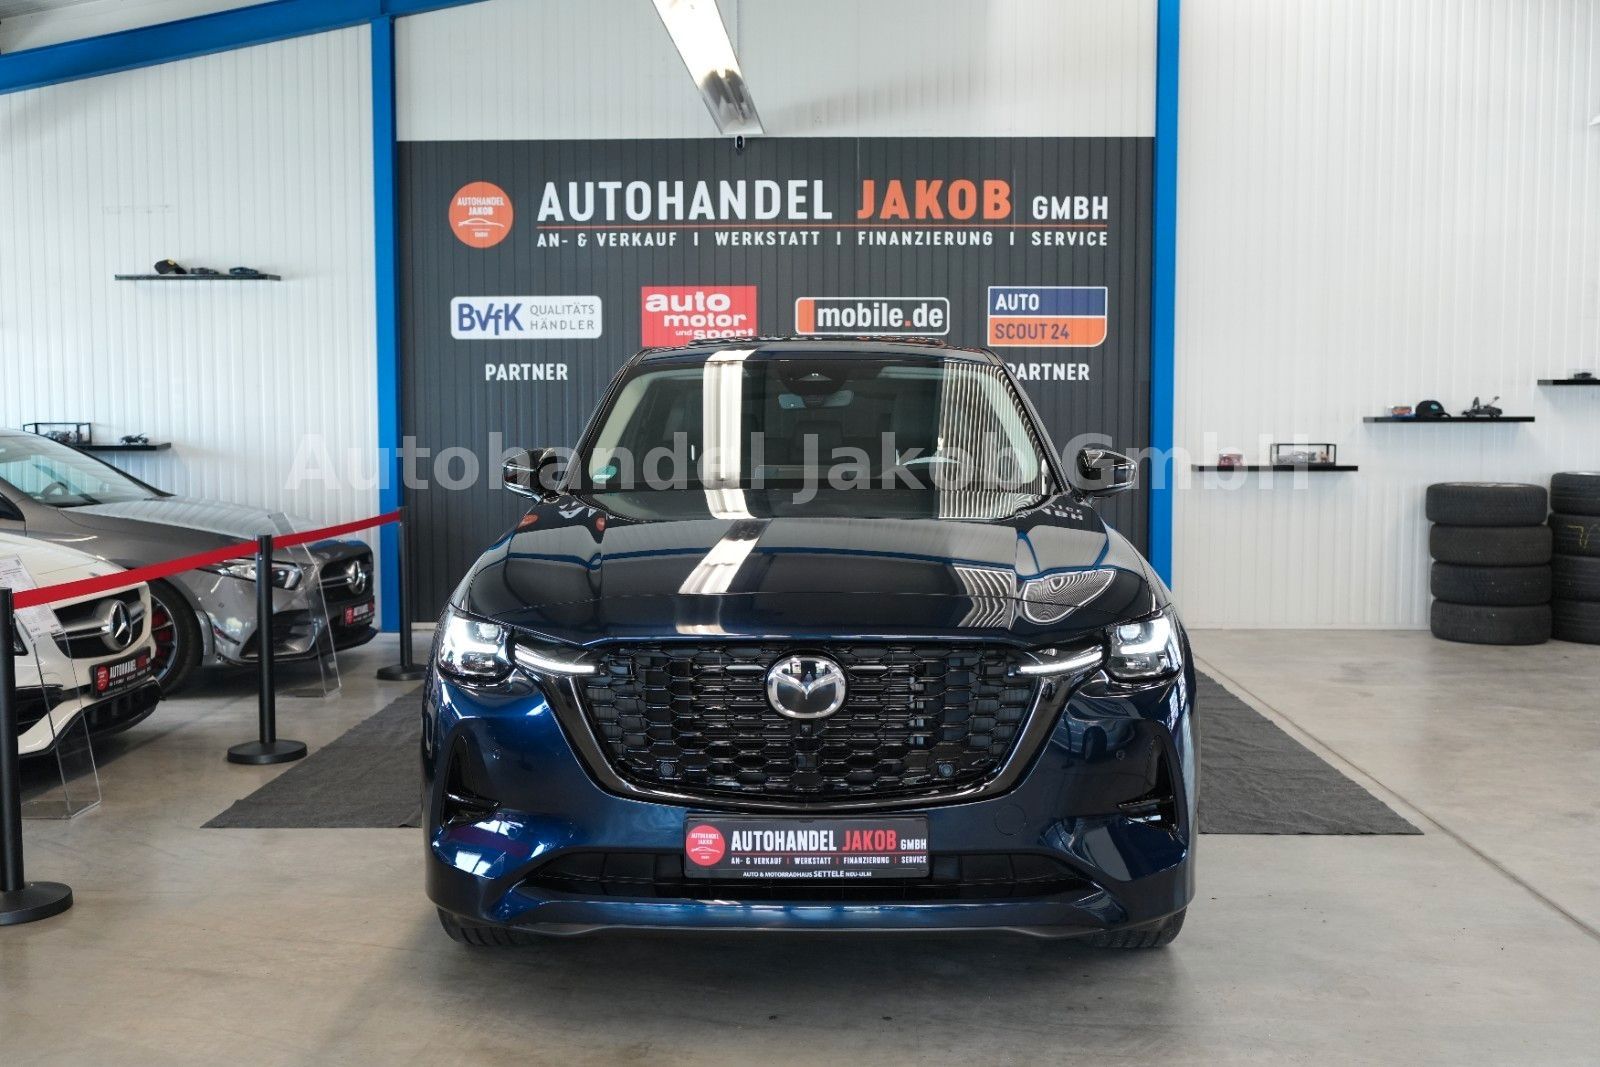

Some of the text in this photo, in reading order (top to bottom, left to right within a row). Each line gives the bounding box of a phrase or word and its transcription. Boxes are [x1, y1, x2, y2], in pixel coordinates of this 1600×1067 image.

[537, 179, 1109, 221] AUTOHANDEL JAKOB GMBH
[469, 206, 493, 216] JAKOB
[537, 233, 568, 248] AN-
[597, 232, 677, 247] VERKAUF
[715, 231, 820, 246] WERKSTATT
[858, 231, 993, 246] FINANZIERUNG
[1031, 231, 1108, 246] SERVICE
[529, 302, 595, 315] QUALITÄTS
[645, 291, 731, 312] auto
[994, 294, 1040, 311] AUTO
[663, 313, 747, 327] motor
[817, 303, 943, 327] mobile.de
[530, 317, 595, 330] HÄNDLER
[994, 324, 1070, 340] SCOUT 24
[485, 364, 569, 381] PARTNER
[731, 830, 927, 851] AUTOHANDEL JAKOB GMBH
[754, 857, 782, 865] VERKAUF
[794, 857, 831, 865] WERKSTATT
[843, 856, 890, 864] FINANZIERUNG
[901, 855, 927, 864] SERVICE
[813, 870, 845, 878] SETTELE
